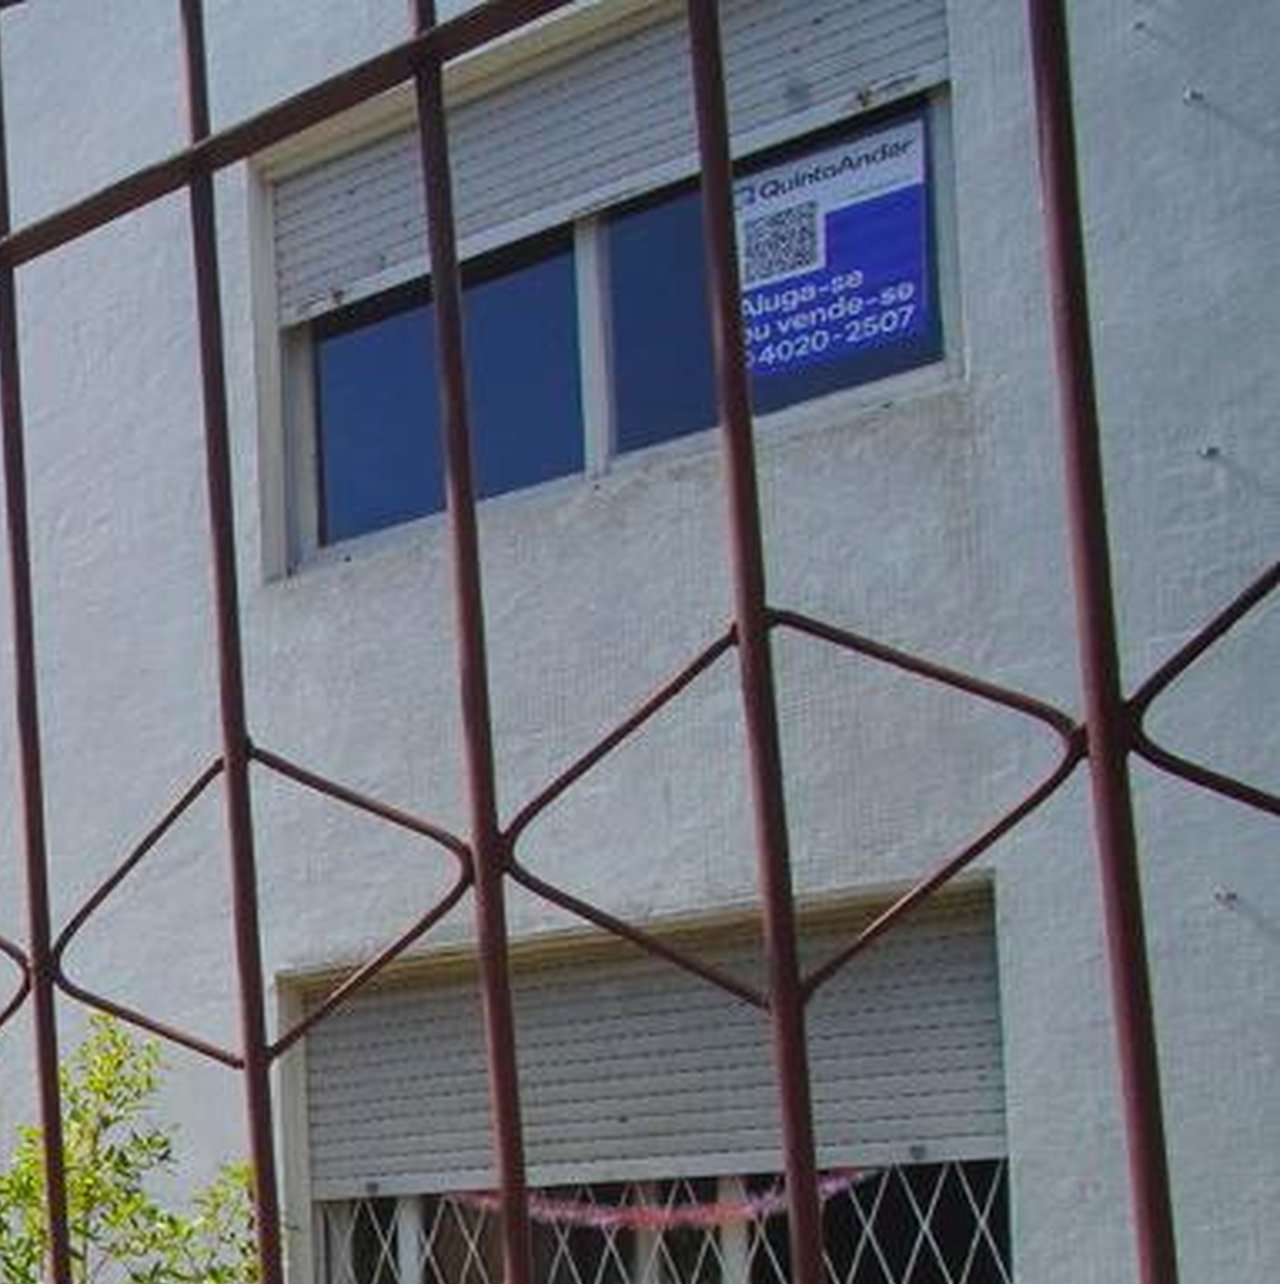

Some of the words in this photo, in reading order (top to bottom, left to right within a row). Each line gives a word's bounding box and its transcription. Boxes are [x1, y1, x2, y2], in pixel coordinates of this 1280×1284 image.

[759, 138, 914, 200] QuintoAndar
[743, 270, 864, 316] Aluga-se
[777, 281, 915, 333] vende-se
[758, 305, 915, 365] 4020-2507
